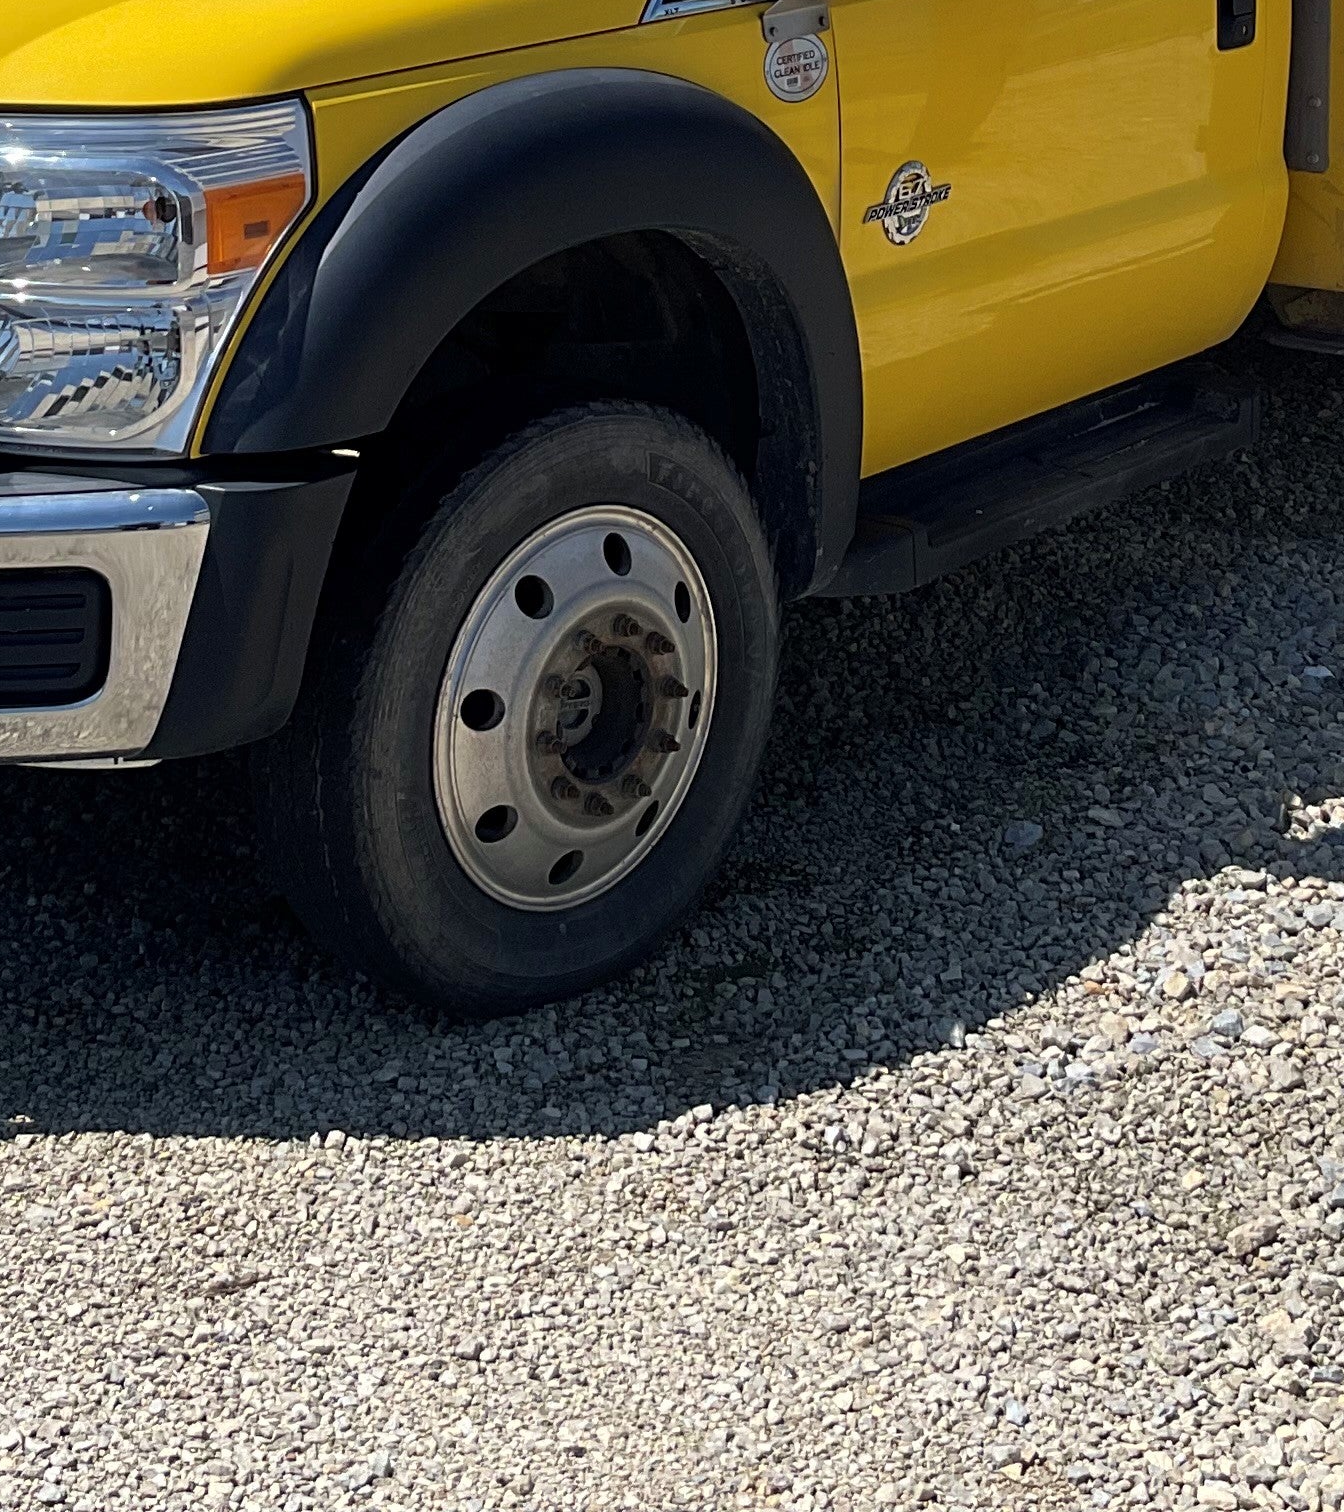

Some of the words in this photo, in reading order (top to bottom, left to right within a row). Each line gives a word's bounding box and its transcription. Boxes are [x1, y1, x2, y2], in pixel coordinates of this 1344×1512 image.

[776, 49, 816, 66] CERTIFIED
[773, 65, 801, 79] CLEAN
[802, 60, 821, 72] IDLE
[867, 198, 911, 223] POWER
[909, 187, 952, 211] STROKE
